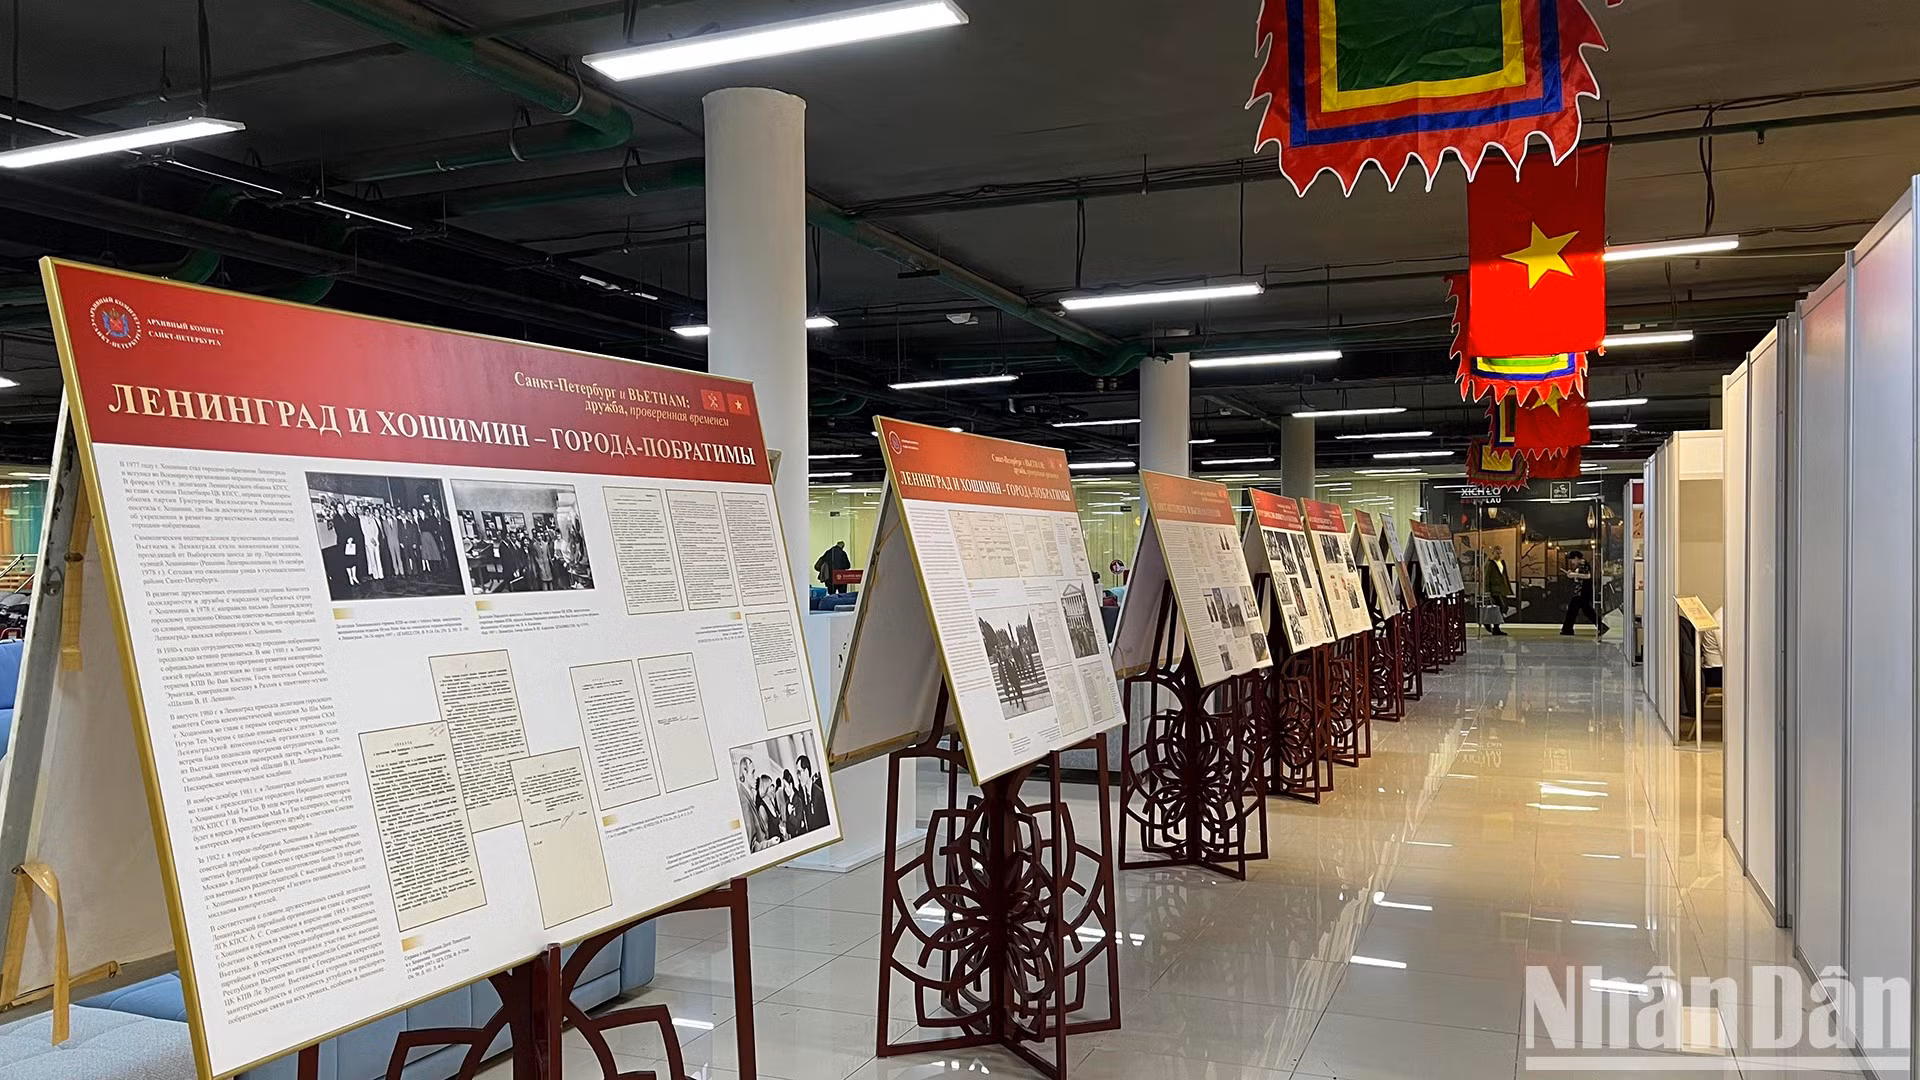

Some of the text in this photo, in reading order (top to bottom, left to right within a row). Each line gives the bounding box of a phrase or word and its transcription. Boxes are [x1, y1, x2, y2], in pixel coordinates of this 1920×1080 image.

[147, 318, 225, 336] АРХИВНЫЙ КОМИТЕТ
[147, 330, 222, 347] САНКТ-ПЕТЕРБУРГА
[514, 371, 690, 409] Санкт-Петербург и ВЬЕТНАМ:
[108, 383, 343, 437] ЛЕНИНГРАД
[345, 407, 372, 434] И
[375, 410, 530, 448] ХОШИМИН
[550, 427, 757, 466] ГОРОДА-ПОБРАТИМЫ
[585, 399, 730, 427] дружба, проверенная временем
[900, 470, 952, 491] ЛЕНИНГРАД
[954, 477, 960, 491] И
[961, 478, 1002, 495] ХОШИМИН
